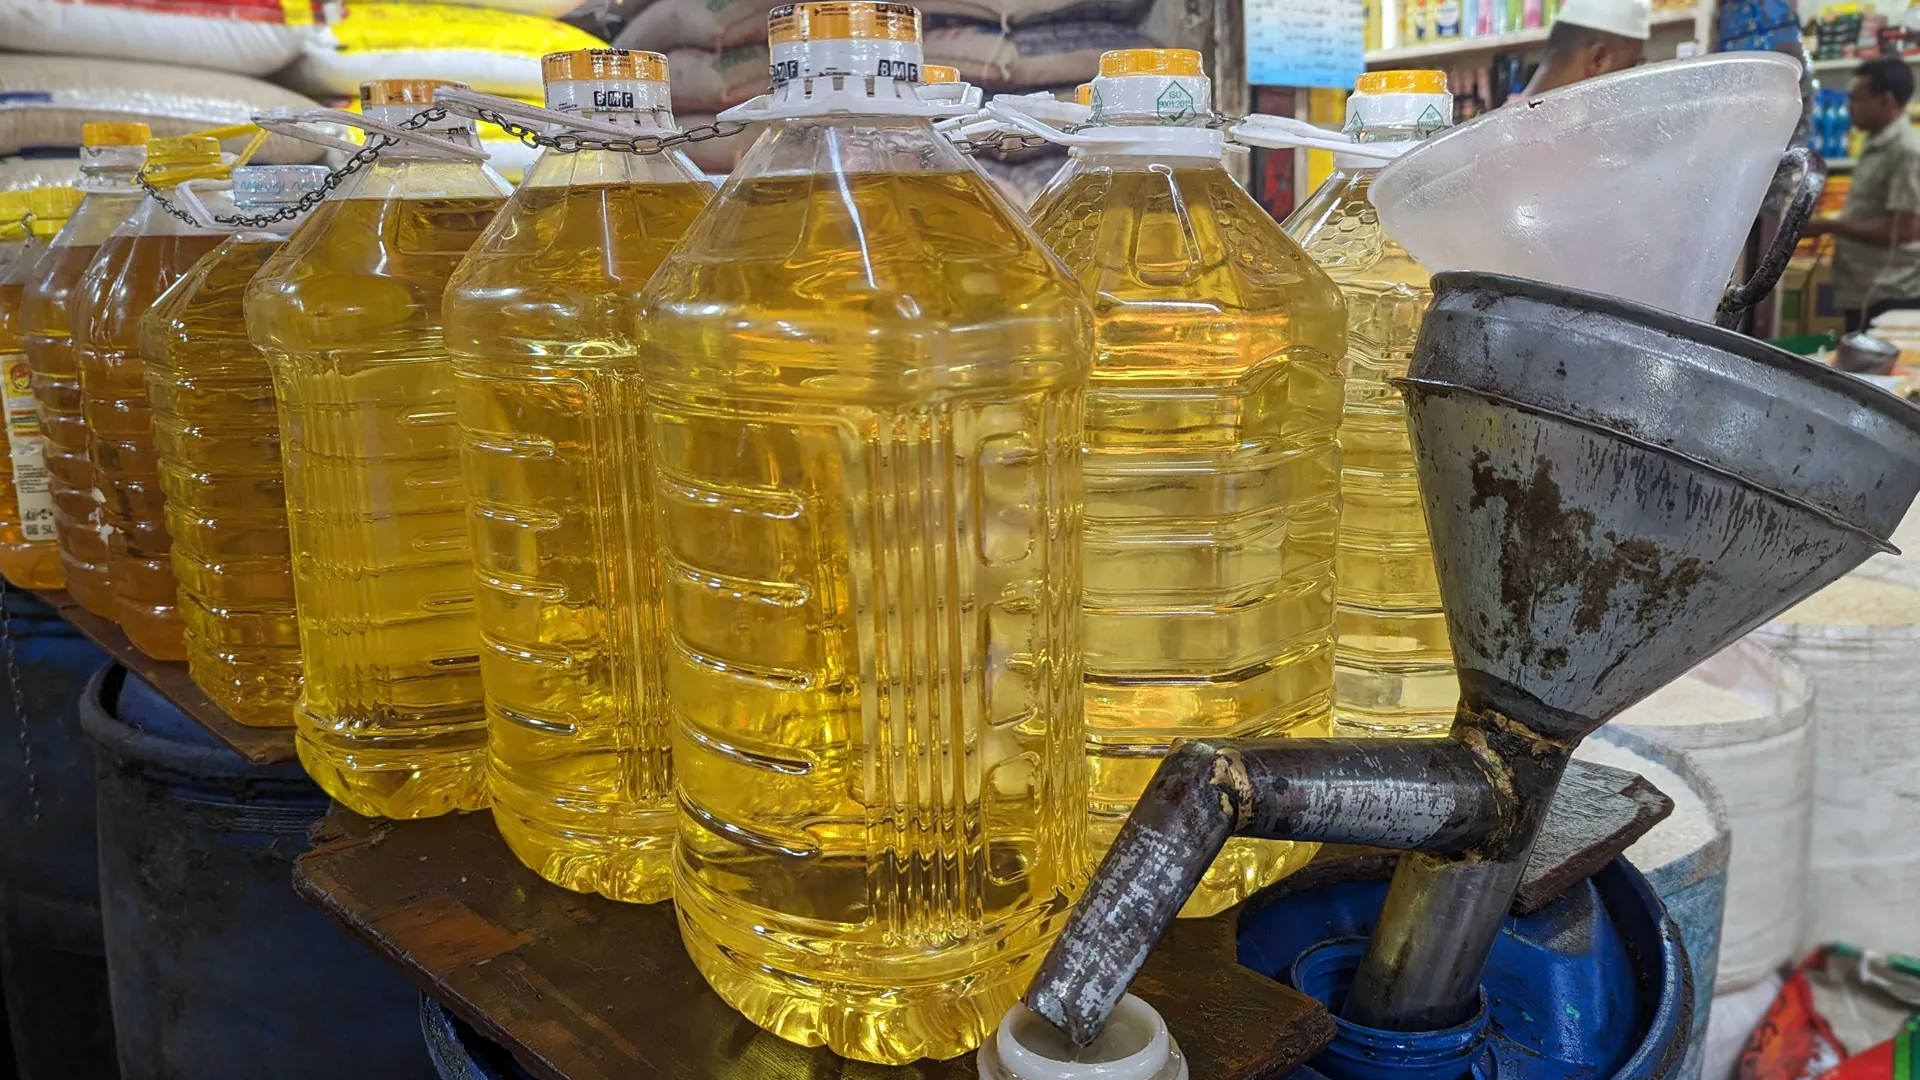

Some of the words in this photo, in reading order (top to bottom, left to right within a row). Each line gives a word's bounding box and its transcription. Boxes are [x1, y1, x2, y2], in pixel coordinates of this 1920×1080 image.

[878, 61, 917, 82] BMF
[595, 92, 632, 107] BMF
[1169, 91, 1182, 99] ISO
